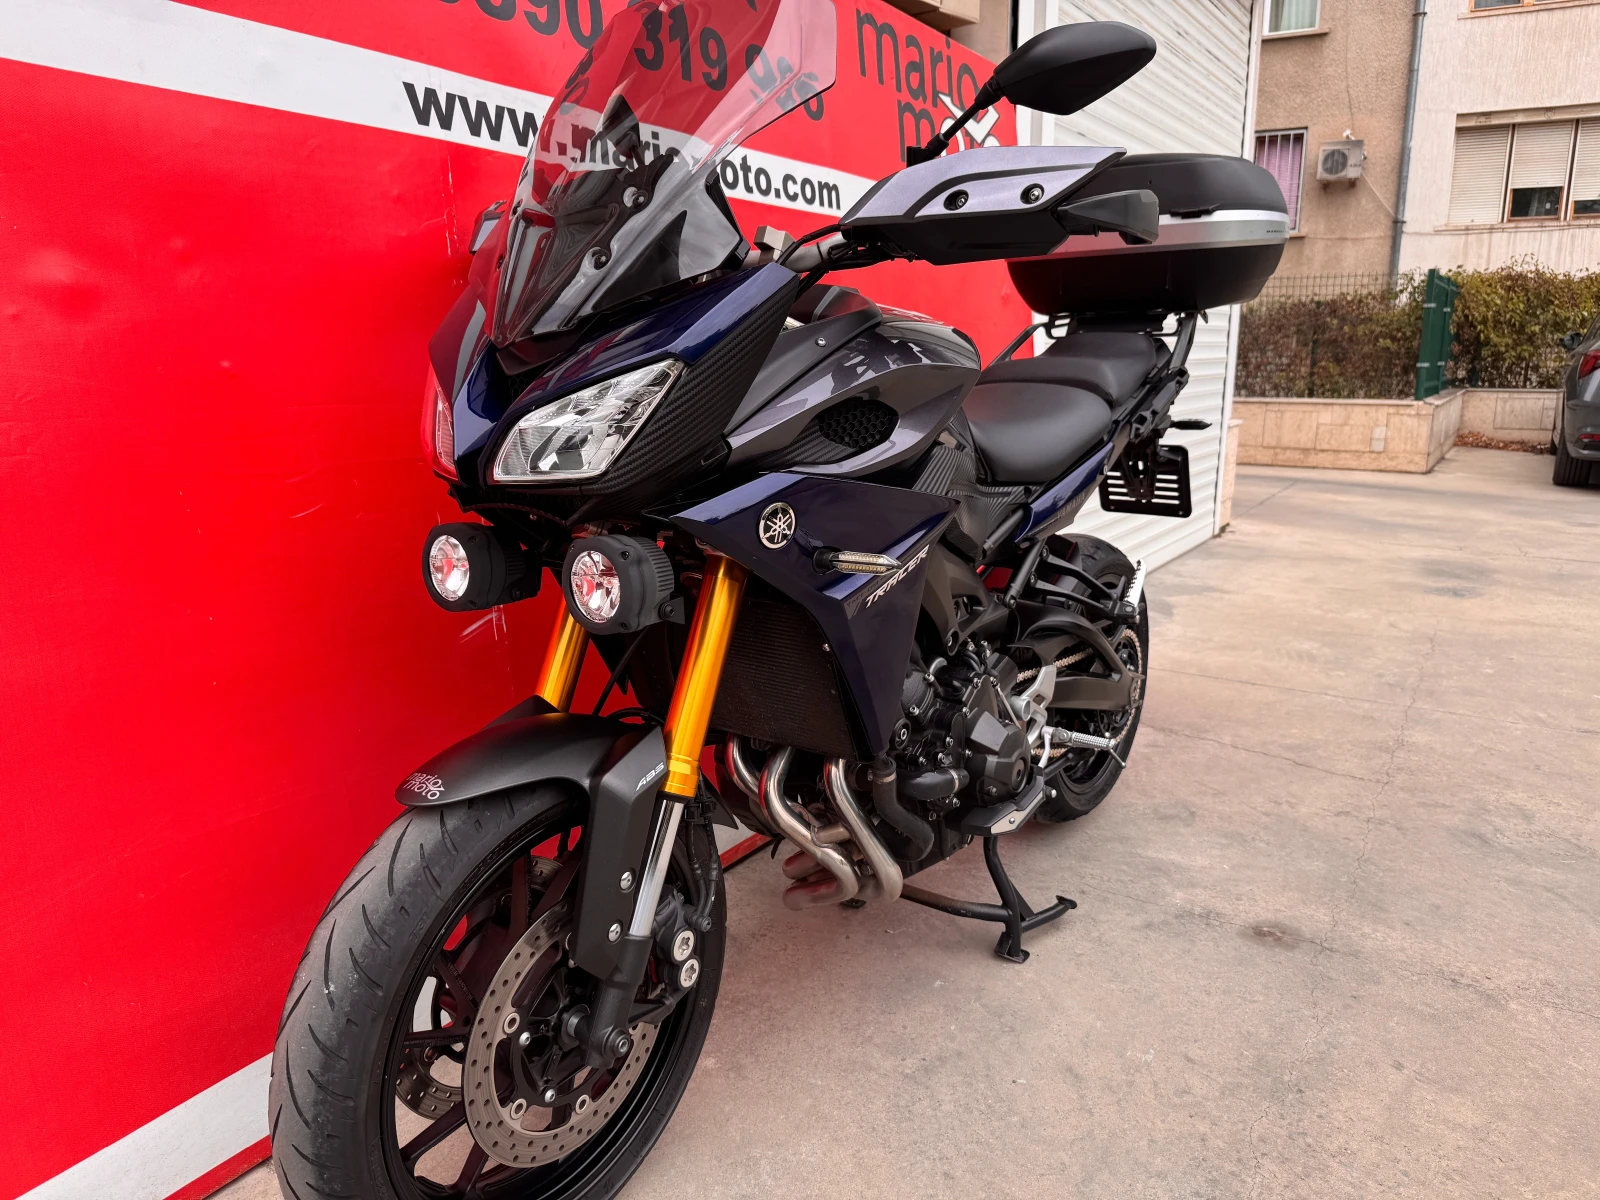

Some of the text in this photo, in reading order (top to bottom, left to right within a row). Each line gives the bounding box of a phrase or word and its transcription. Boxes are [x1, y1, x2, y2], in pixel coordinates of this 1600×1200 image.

[634, 1, 728, 92] 319
[856, 8, 983, 121] mario
[897, 97, 1001, 164] mo
[864, 544, 930, 609] TRACER
[402, 780, 440, 800] moto
[406, 772, 443, 789] mario
[636, 761, 664, 791] ABS
